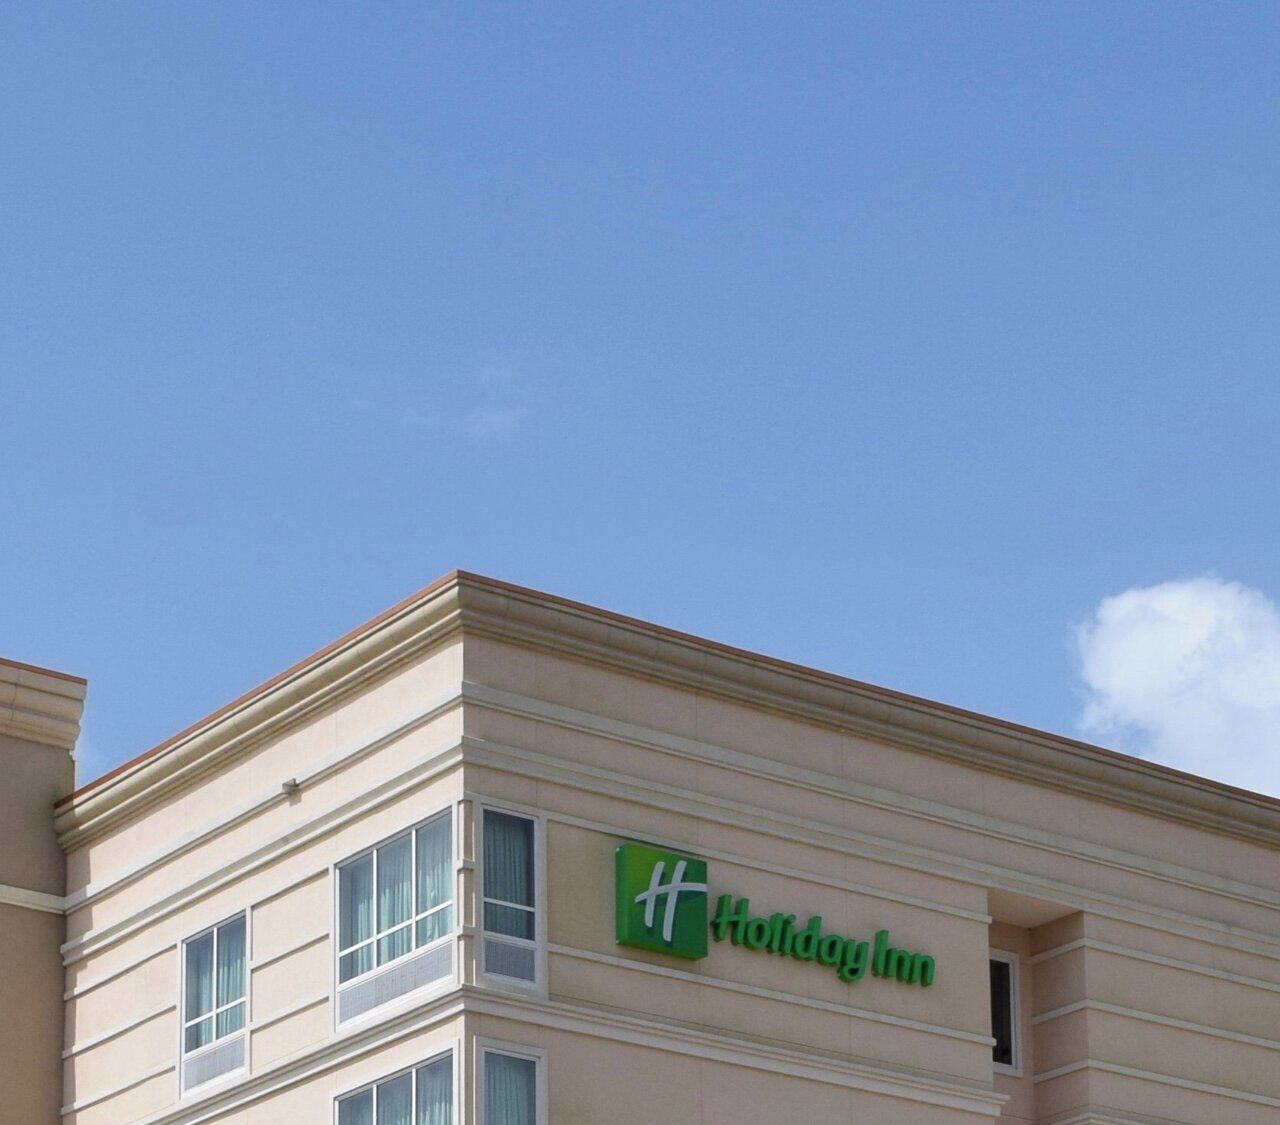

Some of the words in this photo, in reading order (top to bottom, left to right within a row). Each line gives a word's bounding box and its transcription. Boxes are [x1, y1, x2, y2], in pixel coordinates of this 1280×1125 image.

[634, 860, 708, 942] H
[710, 894, 869, 982] Holiday
[872, 929, 936, 987] Inn
